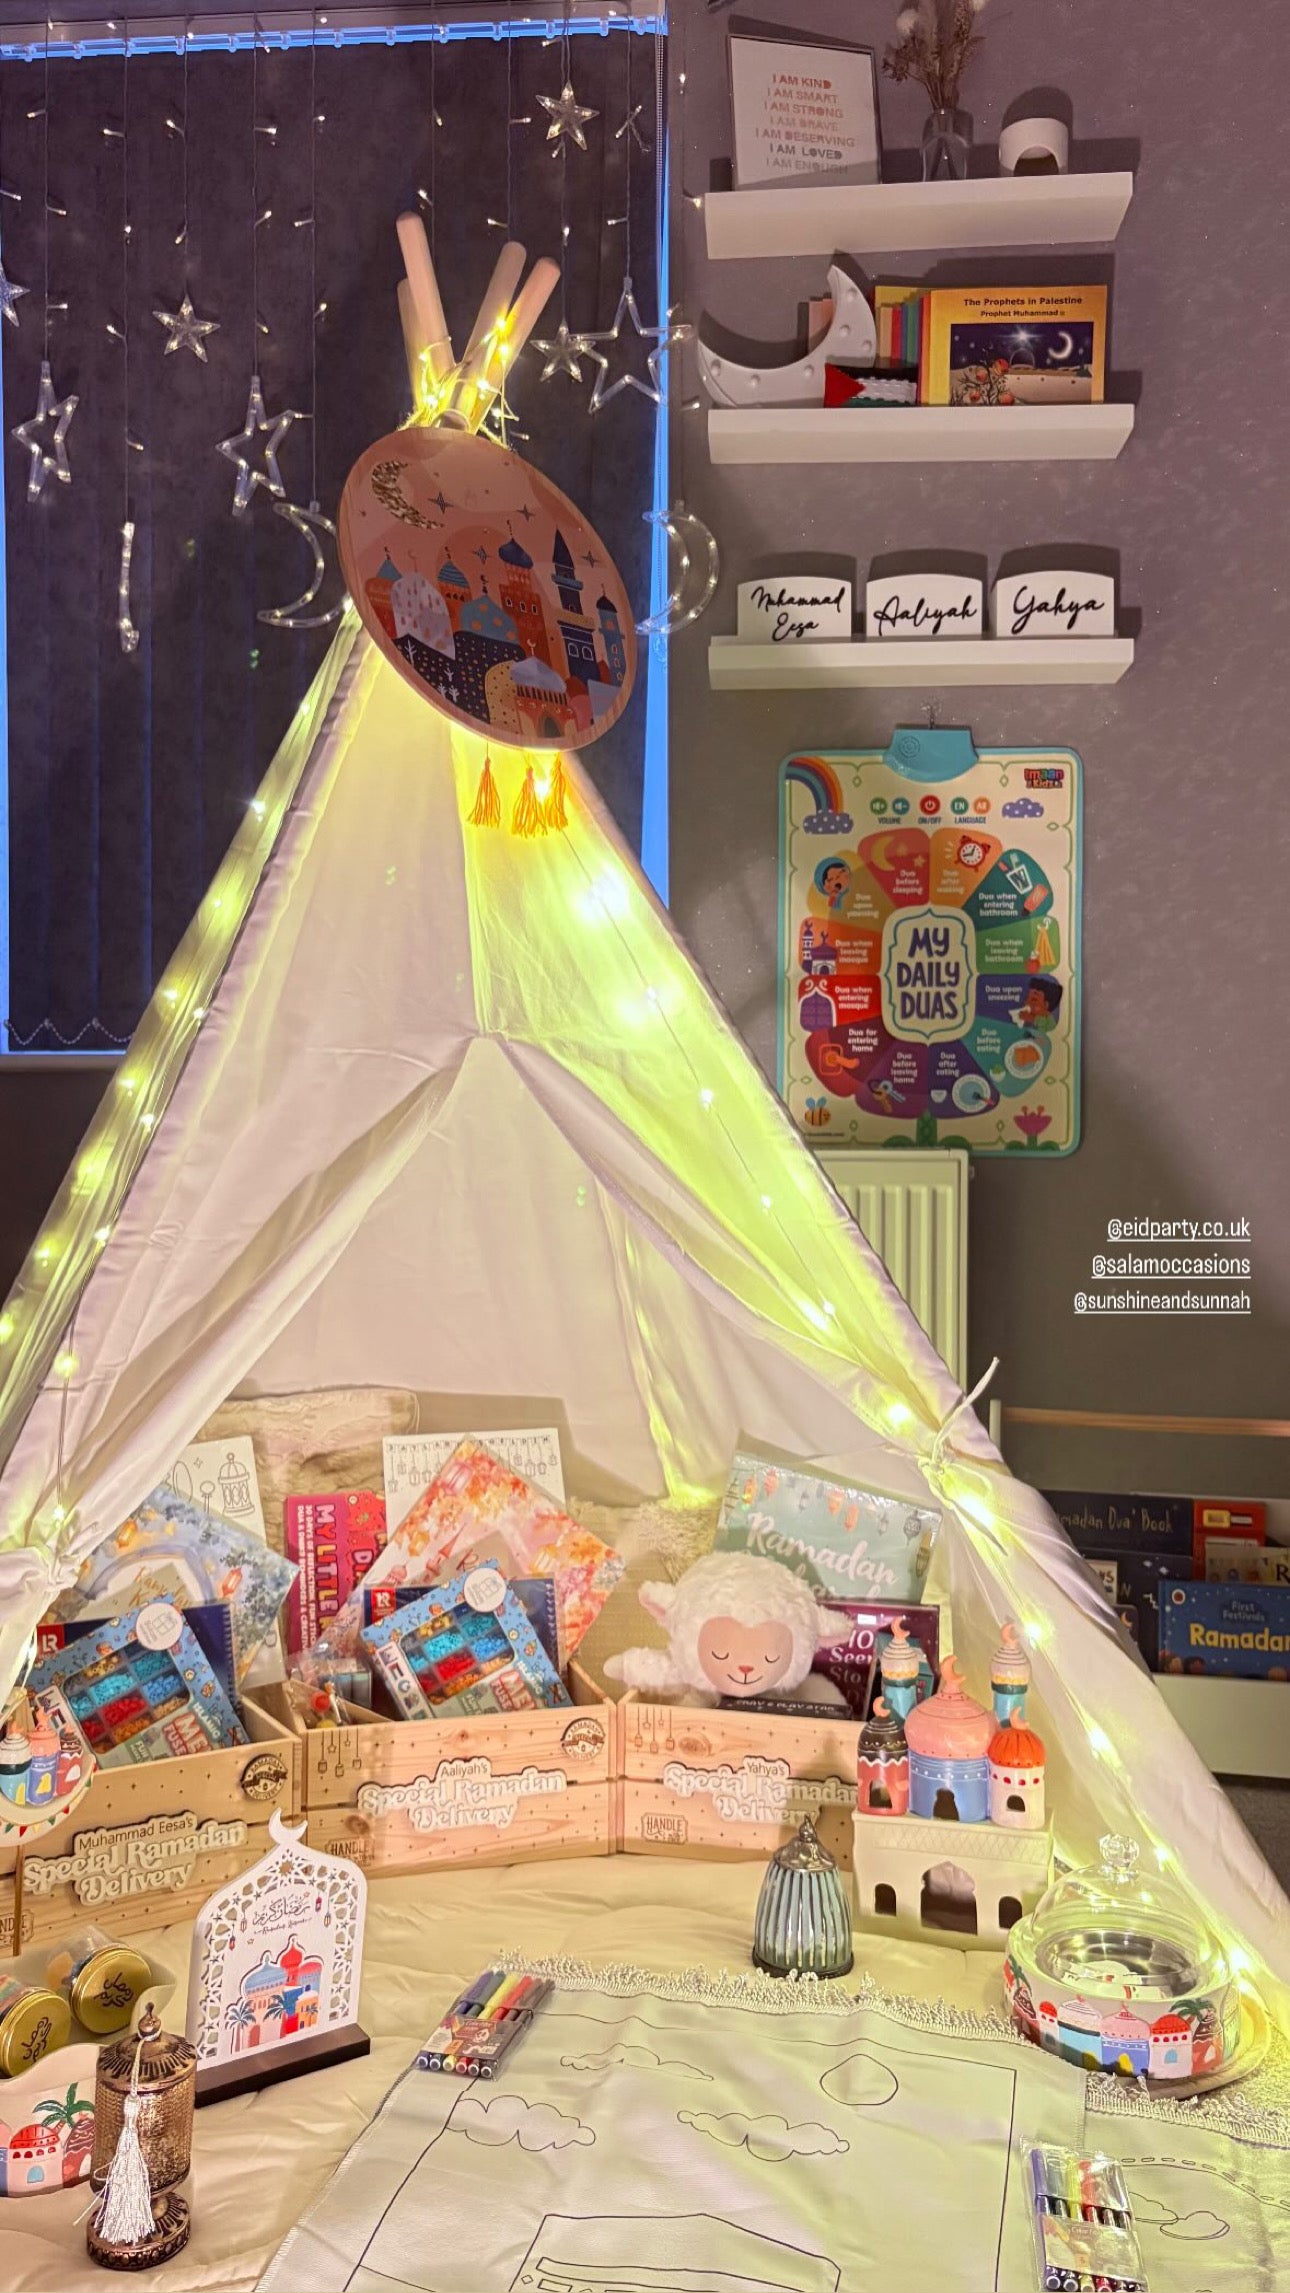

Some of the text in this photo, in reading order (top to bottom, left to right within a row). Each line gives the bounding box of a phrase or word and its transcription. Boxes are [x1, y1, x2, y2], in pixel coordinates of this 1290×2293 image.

[779, 75, 798, 86] AM
[801, 77, 832, 89] KIND
[774, 88, 793, 99] AM
[796, 91, 838, 104] SMART
[770, 102, 790, 112] AM
[792, 104, 844, 118] STRONG
[777, 117, 796, 127] AM
[800, 119, 839, 132] BRAVE
[762, 129, 781, 140] AM
[785, 131, 856, 148] DESERVING
[777, 144, 796, 155] AM
[802, 147, 842, 160] LOVED
[772, 158, 792, 168] AM
[795, 160, 848, 175] ENOUGH
[984, 298, 1025, 307] Prophets
[1028, 297, 1037, 305] in
[1039, 296, 1083, 305] Palestine
[980, 310, 1012, 318] Prophet
[751, 585, 846, 614] Muhammad
[874, 594, 978, 636] Aaliyah
[1010, 586, 1105, 635] Yahya
[954, 802, 965, 810] EN
[878, 817, 902, 825] VOLUME
[918, 817, 942, 825] ON/OFF
[954, 817, 987, 825] LANGUAGE
[893, 886, 923, 895] sleeping
[979, 892, 1017, 900] Dua when
[983, 901, 1014, 910] entering
[979, 909, 1018, 917] bathroom
[835, 939, 873, 947] Dua when
[907, 927, 950, 958] MY
[985, 939, 1023, 947] Dua when
[840, 948, 868, 956] leaving
[990, 947, 1019, 955] leaving
[985, 955, 1024, 963] bathroom
[896, 962, 960, 988] DAILY
[985, 985, 1023, 995] Dua upon
[838, 994, 870, 1002] entering
[987, 994, 1020, 1002] sneezing
[838, 1003, 869, 1011] mosque
[900, 991, 959, 1020] DUAS
[848, 1028, 878, 1036] Dua for
[981, 1028, 997, 1036] Dua
[847, 1037, 879, 1046] entering
[976, 1037, 1001, 1045] before
[851, 1045, 874, 1053] home
[976, 1045, 1001, 1054] eating
[896, 1052, 912, 1060] Dua
[940, 1052, 956, 1060] Dua
[892, 1060, 917, 1068] before
[938, 1060, 958, 1068] after
[890, 1068, 918, 1077] leaving
[936, 1068, 960, 1078] eating
[893, 1076, 916, 1084] home
[297, 1505, 305, 1523] DUA
[305, 1504, 313, 1515] 30
[315, 1504, 337, 1540] MY
[1058, 1506, 1103, 1530] madan
[1141, 1507, 1174, 1533] Book
[305, 1516, 313, 1539] DAYS
[306, 1540, 314, 1550] OF
[745, 1511, 901, 1586] Ramadan
[316, 1543, 339, 1611] LITTLE
[308, 1603, 316, 1620] FUN
[1231, 1600, 1255, 1612] First
[1222, 1609, 1266, 1623] Festivals
[848, 1629, 875, 1649] 10
[829, 1647, 873, 1665] Seer
[192, 1701, 221, 1740] ISLAMIC
[162, 1724, 188, 1757] FUSE
[440, 1763, 489, 1778] Aaliyah's
[747, 1761, 786, 1777] Yahya's
[665, 1764, 750, 1796] Special
[360, 1768, 564, 1814] Special Ramadan
[413, 1803, 515, 1829] Delivery
[647, 1815, 683, 1832] HANDLE
[79, 1815, 194, 1850] Muhammad Eesa's
[23, 1823, 247, 1891] Special Ramadan
[79, 1862, 193, 1903] Delivery
